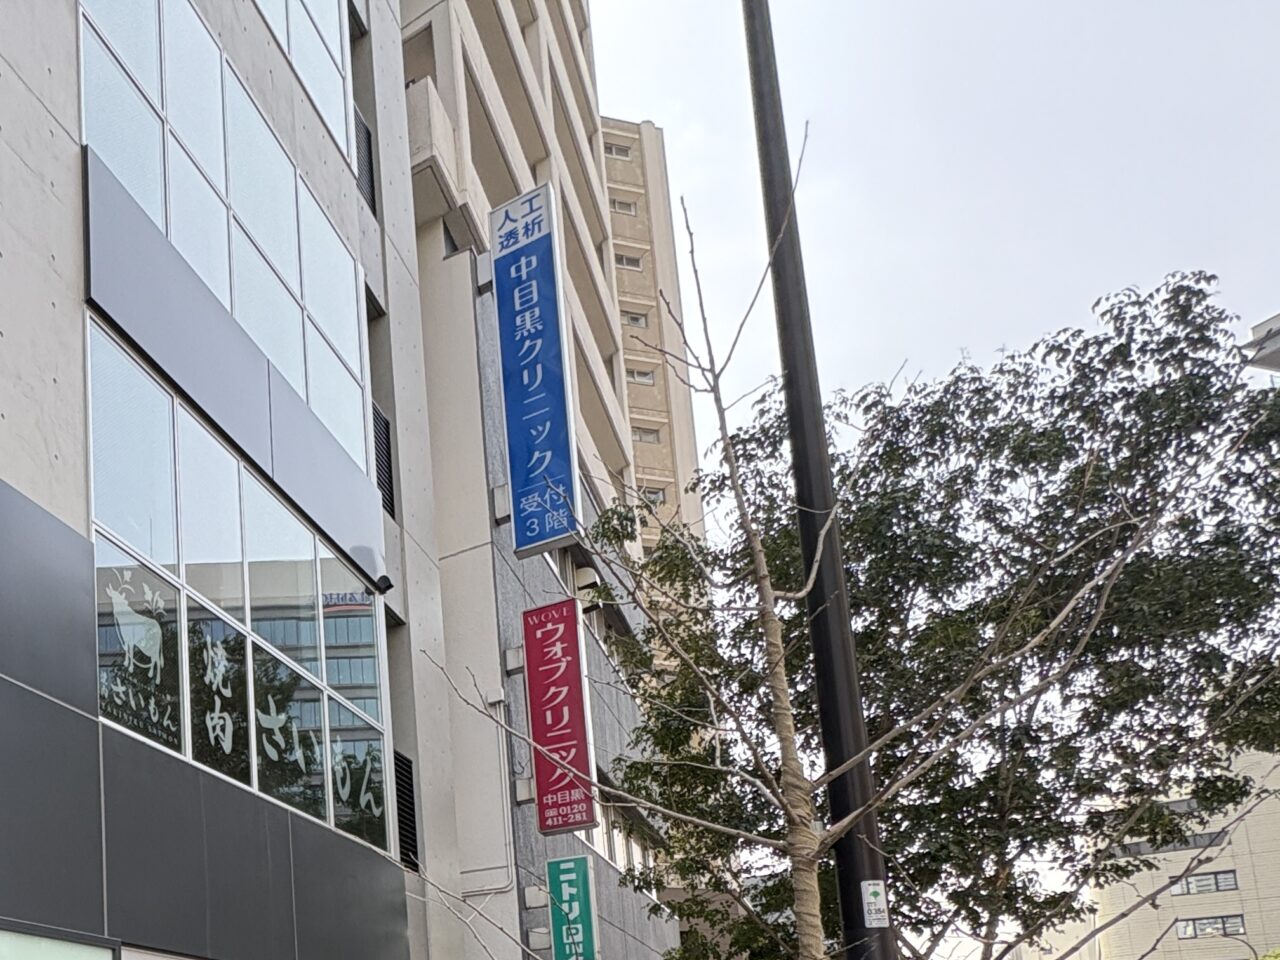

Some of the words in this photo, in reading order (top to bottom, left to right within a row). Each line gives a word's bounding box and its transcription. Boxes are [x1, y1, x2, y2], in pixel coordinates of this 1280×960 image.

[498, 193, 543, 232] 人工
[499, 214, 544, 252] 透析
[510, 255, 552, 478] 中目黒クリニック
[520, 484, 566, 517] 受付
[526, 508, 568, 537] 3階
[111, 677, 177, 731] さいもん
[204, 634, 233, 754] 焼肉
[535, 622, 577, 790] ウォブクリニック
[257, 695, 382, 817] さいもん
[543, 788, 585, 805] 中目黒
[559, 803, 586, 815] 0120
[560, 862, 579, 920] ニトリ
